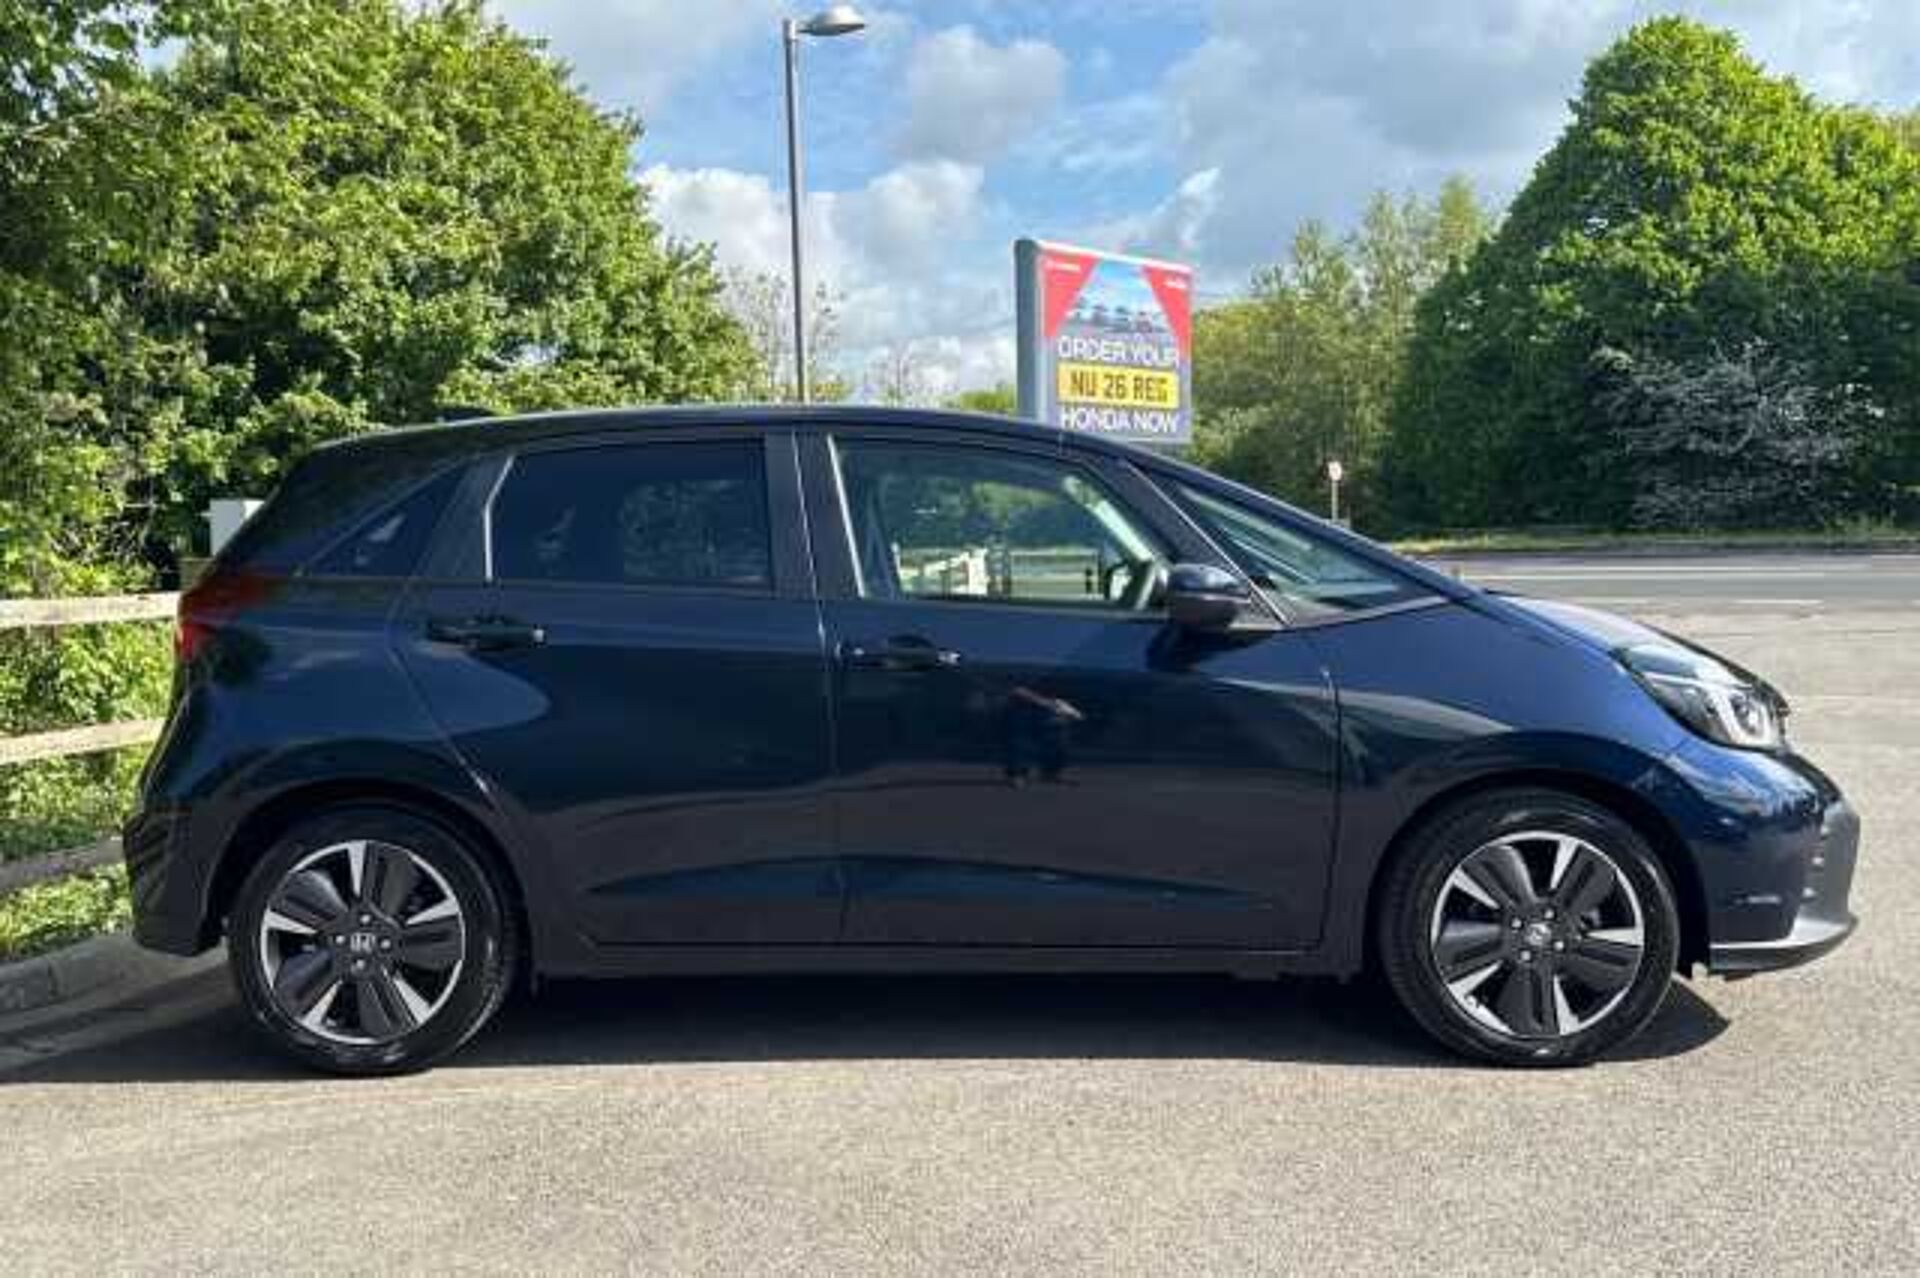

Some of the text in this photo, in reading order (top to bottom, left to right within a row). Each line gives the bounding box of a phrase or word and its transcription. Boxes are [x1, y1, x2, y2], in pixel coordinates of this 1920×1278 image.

[1059, 336, 1179, 369] ORDER YOUR
[1070, 371, 1096, 397] NU
[1103, 374, 1127, 400] 26
[1061, 404, 1180, 433] HONDA NOW
